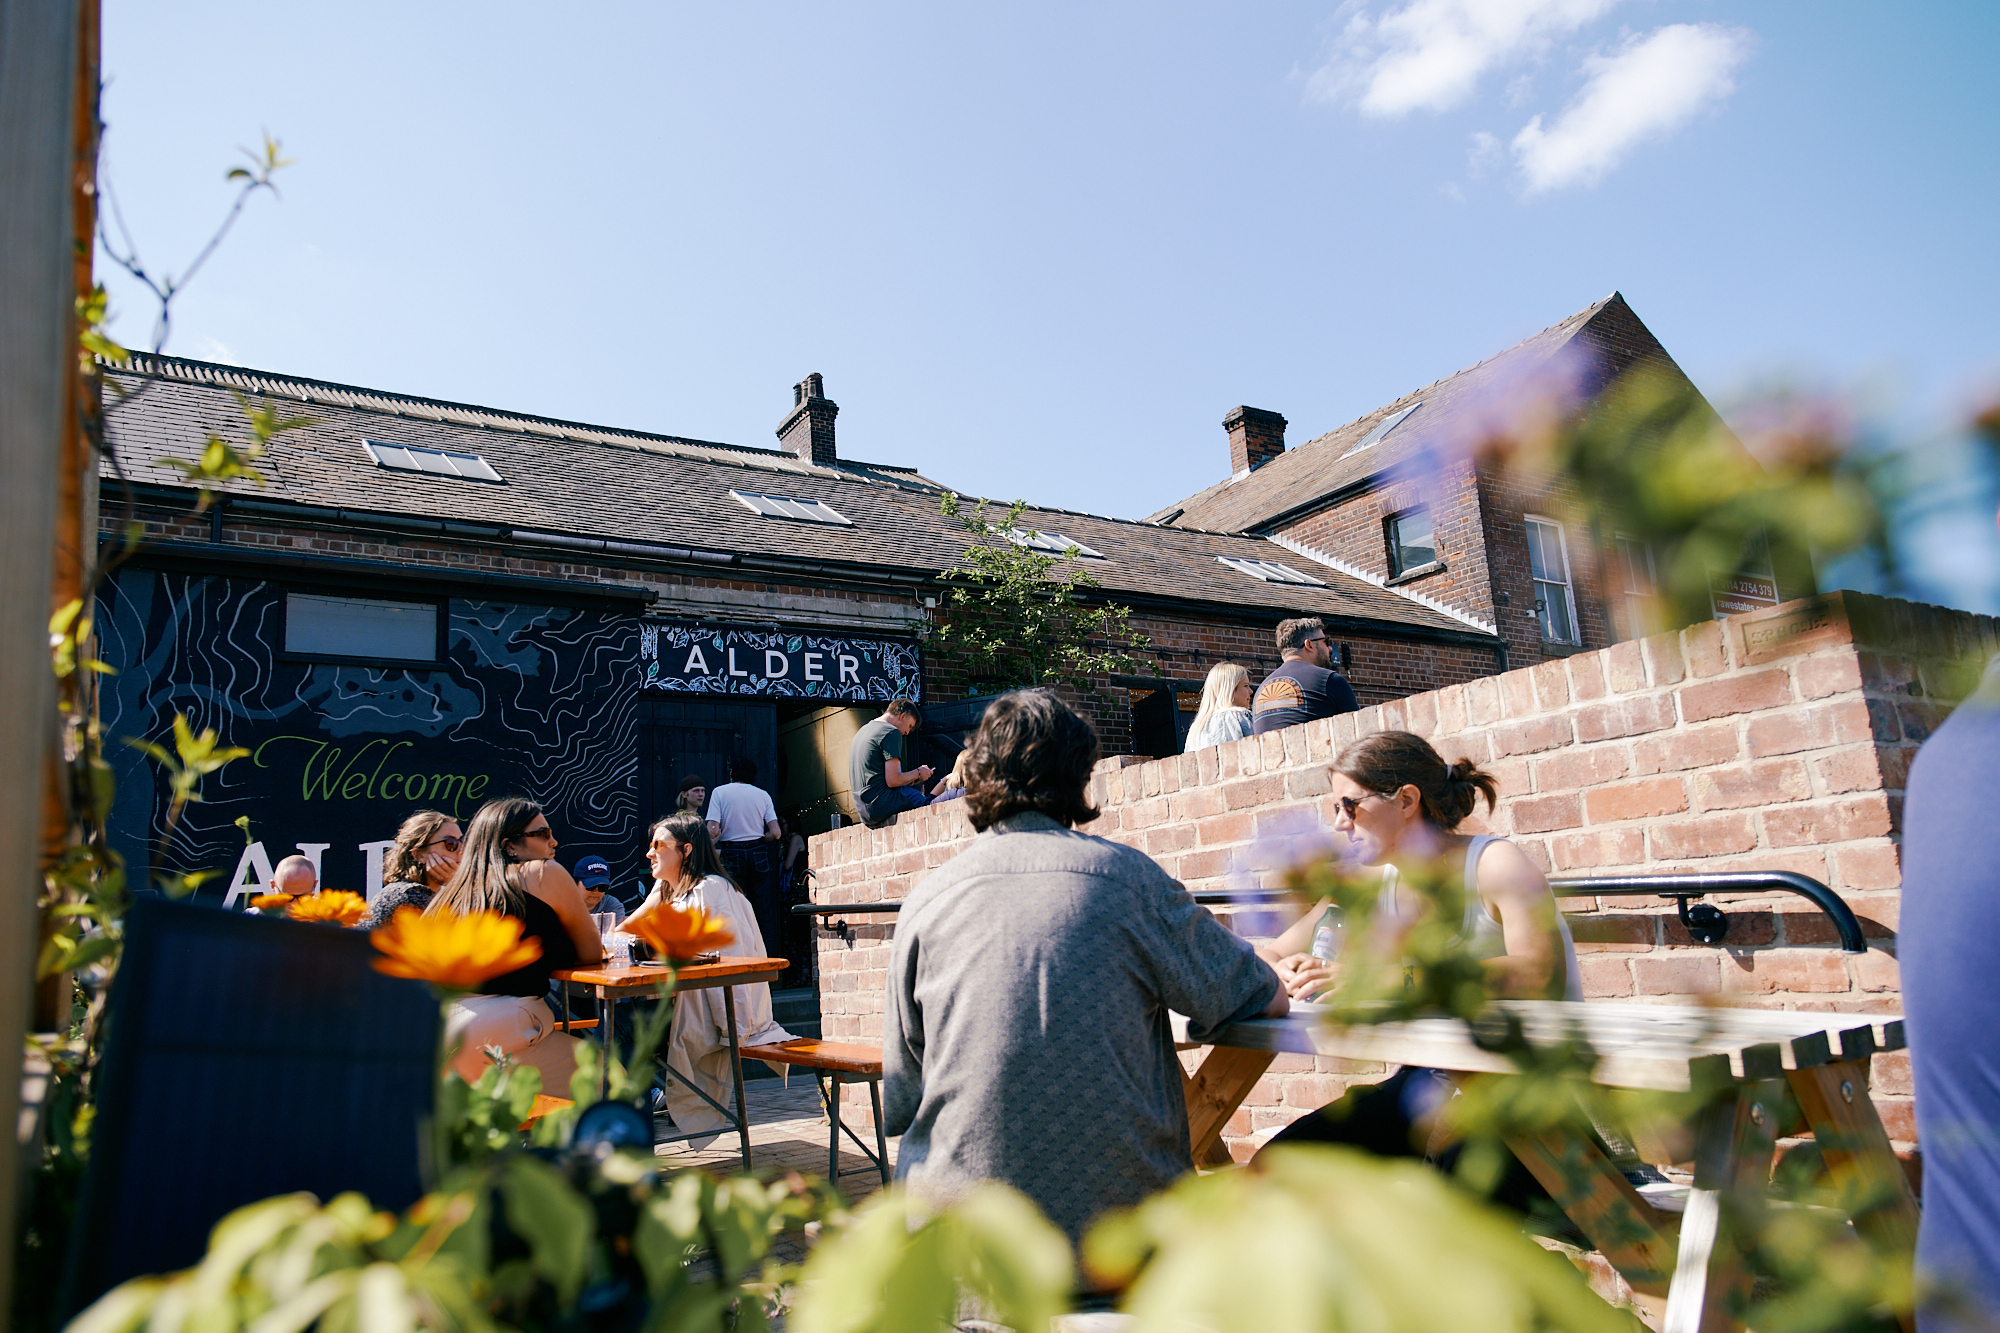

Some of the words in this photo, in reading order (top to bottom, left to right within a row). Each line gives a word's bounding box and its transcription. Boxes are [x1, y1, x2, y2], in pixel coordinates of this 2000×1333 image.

[1720, 579, 1738, 591] 0114
[1739, 581, 1758, 594] 2754
[1758, 584, 1773, 597] 379
[1717, 600, 1764, 612] rawestatesc
[684, 645, 861, 684] ALDER
[253, 735, 490, 822] Welcome
